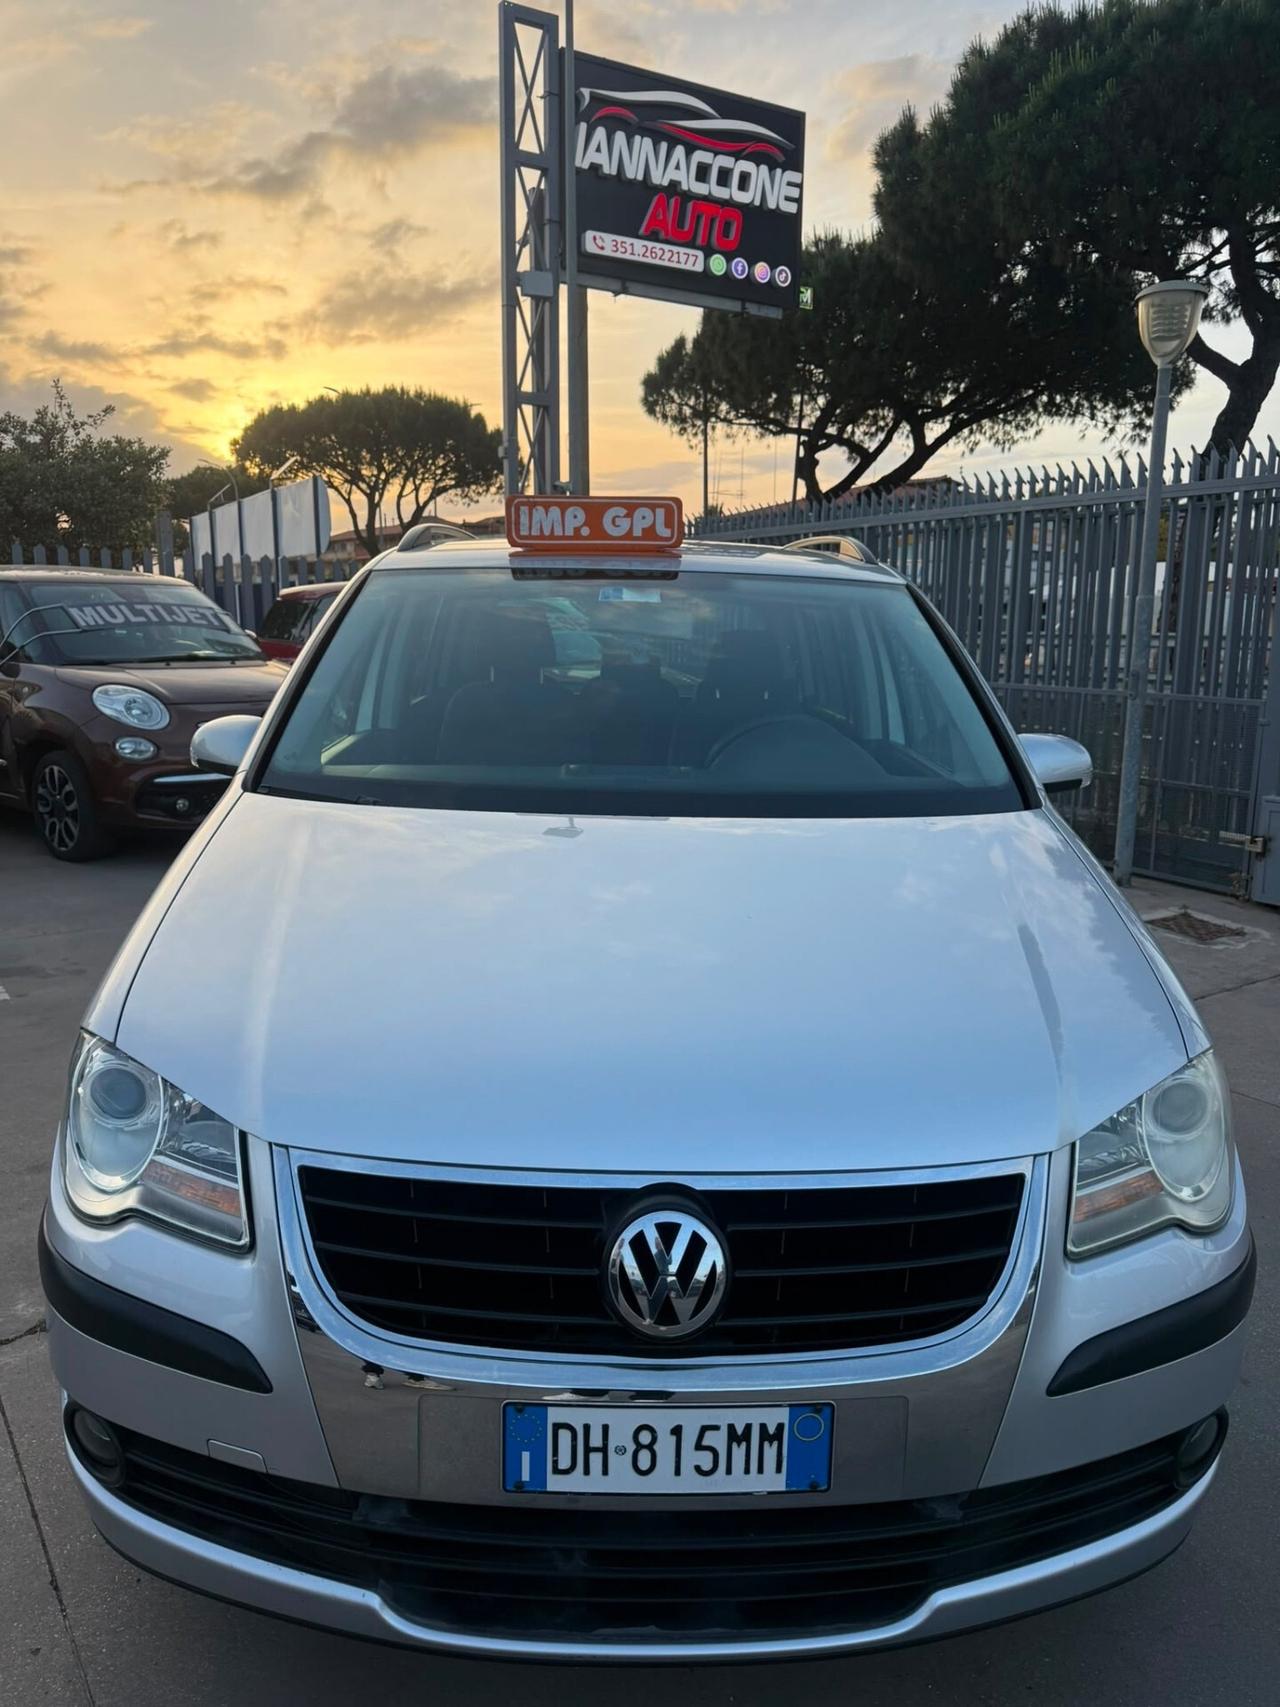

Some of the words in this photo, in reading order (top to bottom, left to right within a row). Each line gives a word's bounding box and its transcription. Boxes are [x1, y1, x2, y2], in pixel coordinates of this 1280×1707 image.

[575, 121, 803, 214] IANNACCONE
[641, 192, 743, 251] AUTO
[610, 239, 699, 268] 351.2622177
[519, 505, 591, 537] IMP.
[602, 506, 672, 537] GPL
[69, 605, 222, 627] MULTIJET
[551, 1422, 610, 1477] DH
[630, 1422, 786, 1477] 815MM
